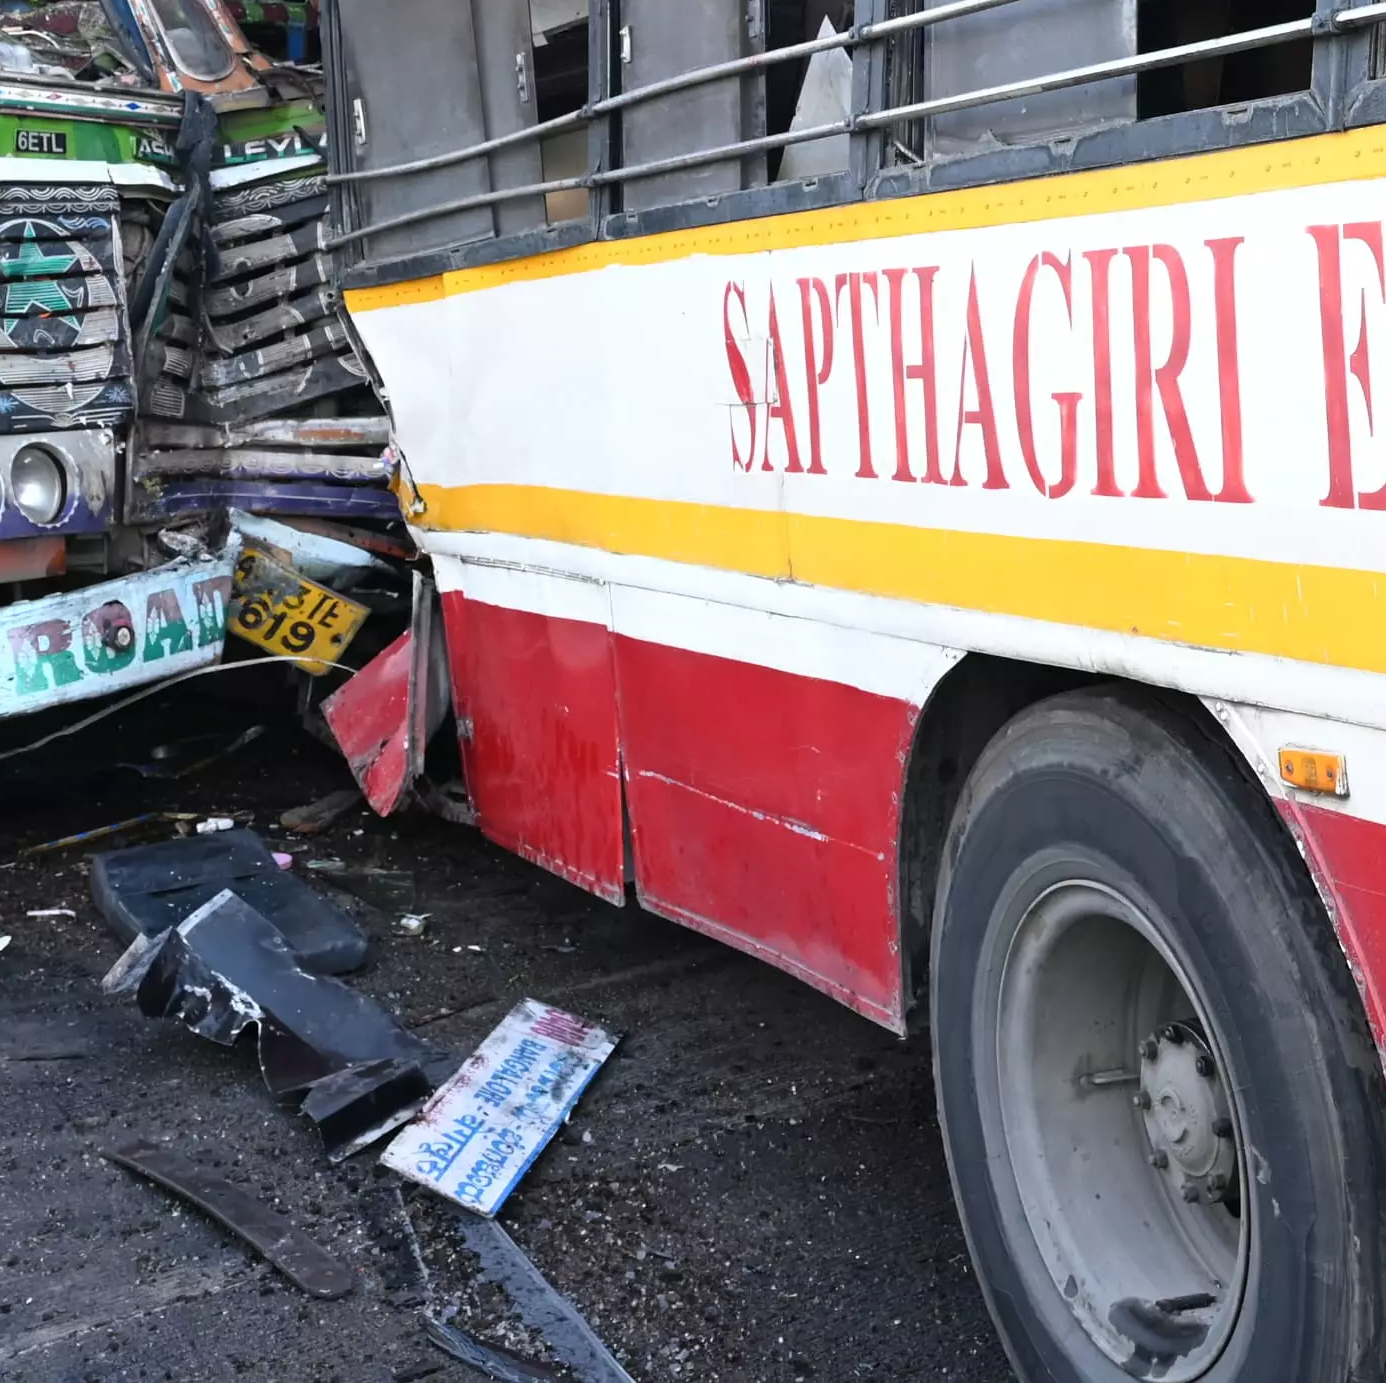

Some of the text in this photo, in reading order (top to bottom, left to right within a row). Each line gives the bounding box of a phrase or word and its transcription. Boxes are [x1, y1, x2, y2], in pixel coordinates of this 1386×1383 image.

[17, 131, 64, 154] 6ETL
[723, 235, 1256, 504] SAPTHAGIRI
[7, 575, 233, 696] ROAD
[473, 1039, 547, 1108] BANGALORE
